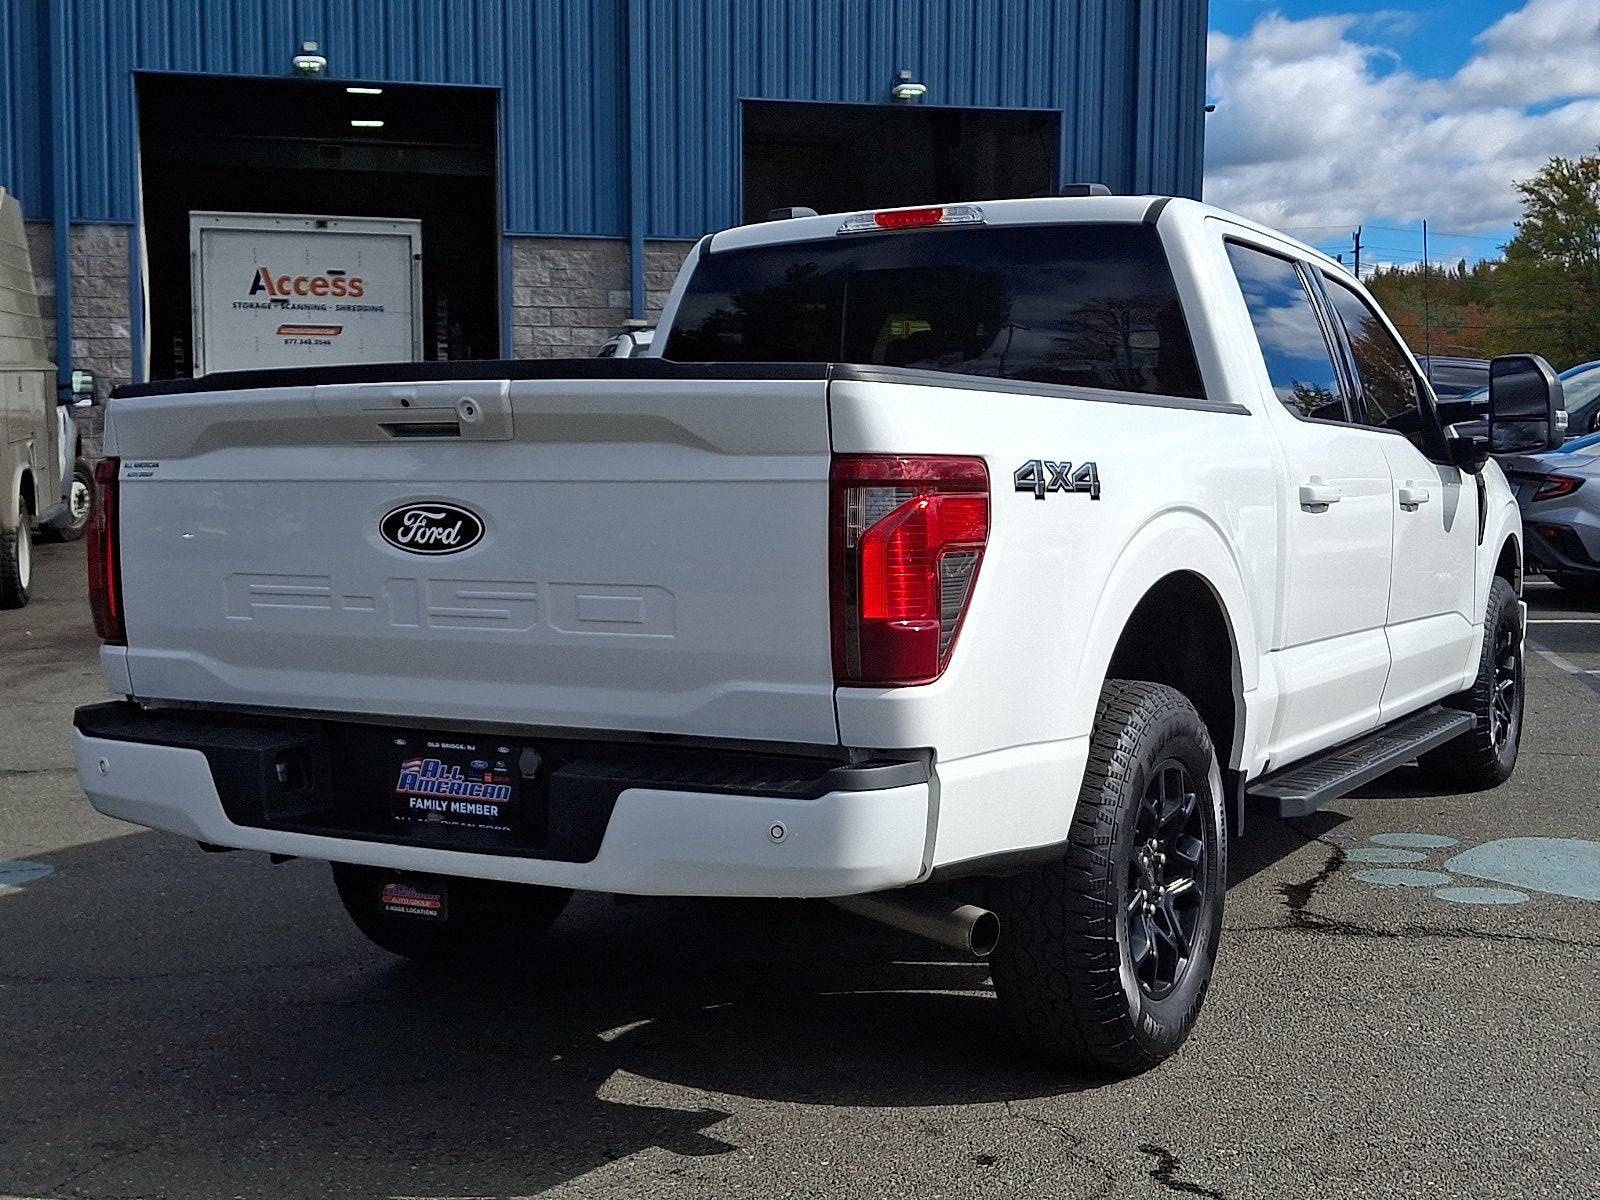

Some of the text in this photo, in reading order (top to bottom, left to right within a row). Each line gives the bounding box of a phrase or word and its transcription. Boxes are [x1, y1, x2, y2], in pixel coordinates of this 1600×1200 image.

[249, 267, 365, 298] Access
[232, 301, 271, 310] STORAGE
[281, 302, 326, 311] SCANNING
[336, 304, 384, 312] SHREDDING
[397, 510, 461, 546] Ford
[223, 572, 675, 638] F-150
[409, 797, 499, 817] FAMILY MEMBER
[406, 907, 438, 916] LOCATIONS
